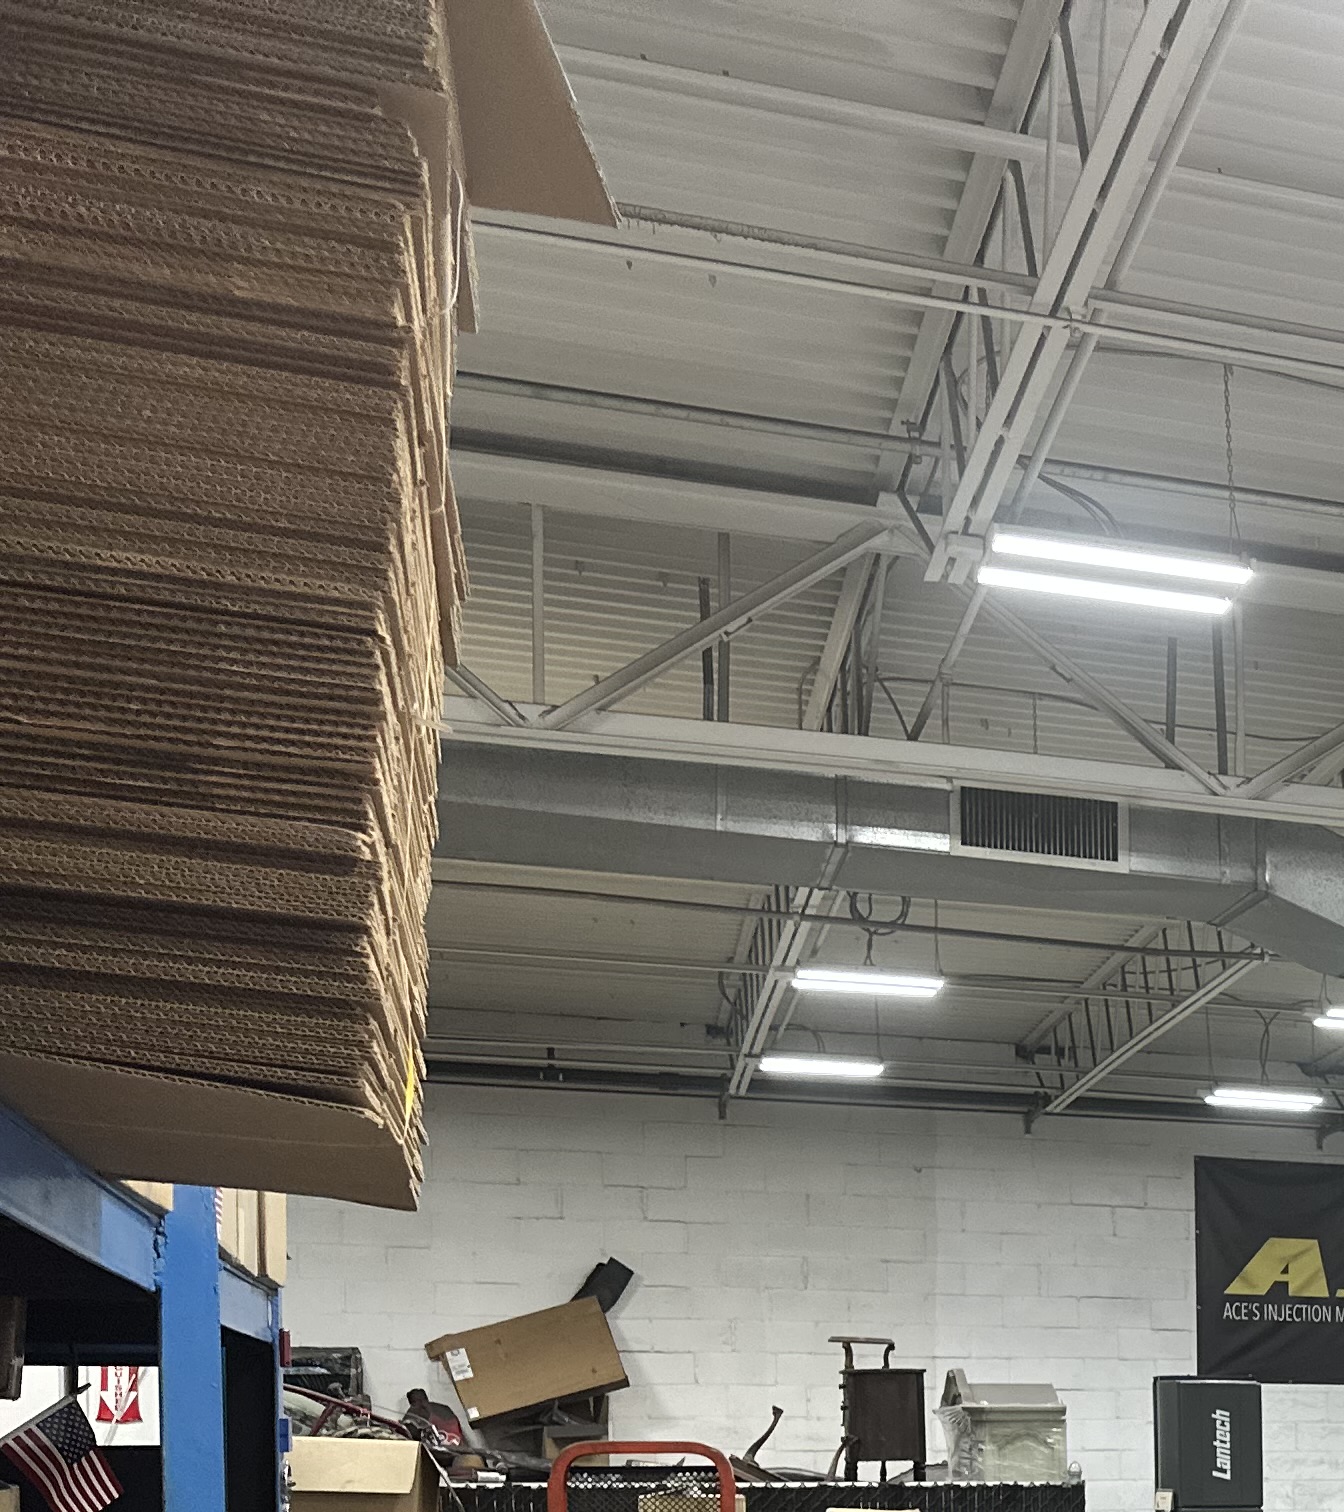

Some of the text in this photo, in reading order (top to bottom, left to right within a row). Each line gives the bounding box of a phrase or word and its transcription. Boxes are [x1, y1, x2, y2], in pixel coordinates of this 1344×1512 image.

[1223, 1302, 1260, 1321] ACE'S
[1264, 1303, 1334, 1323] INJECTION
[1211, 1409, 1231, 1480] Lantech
